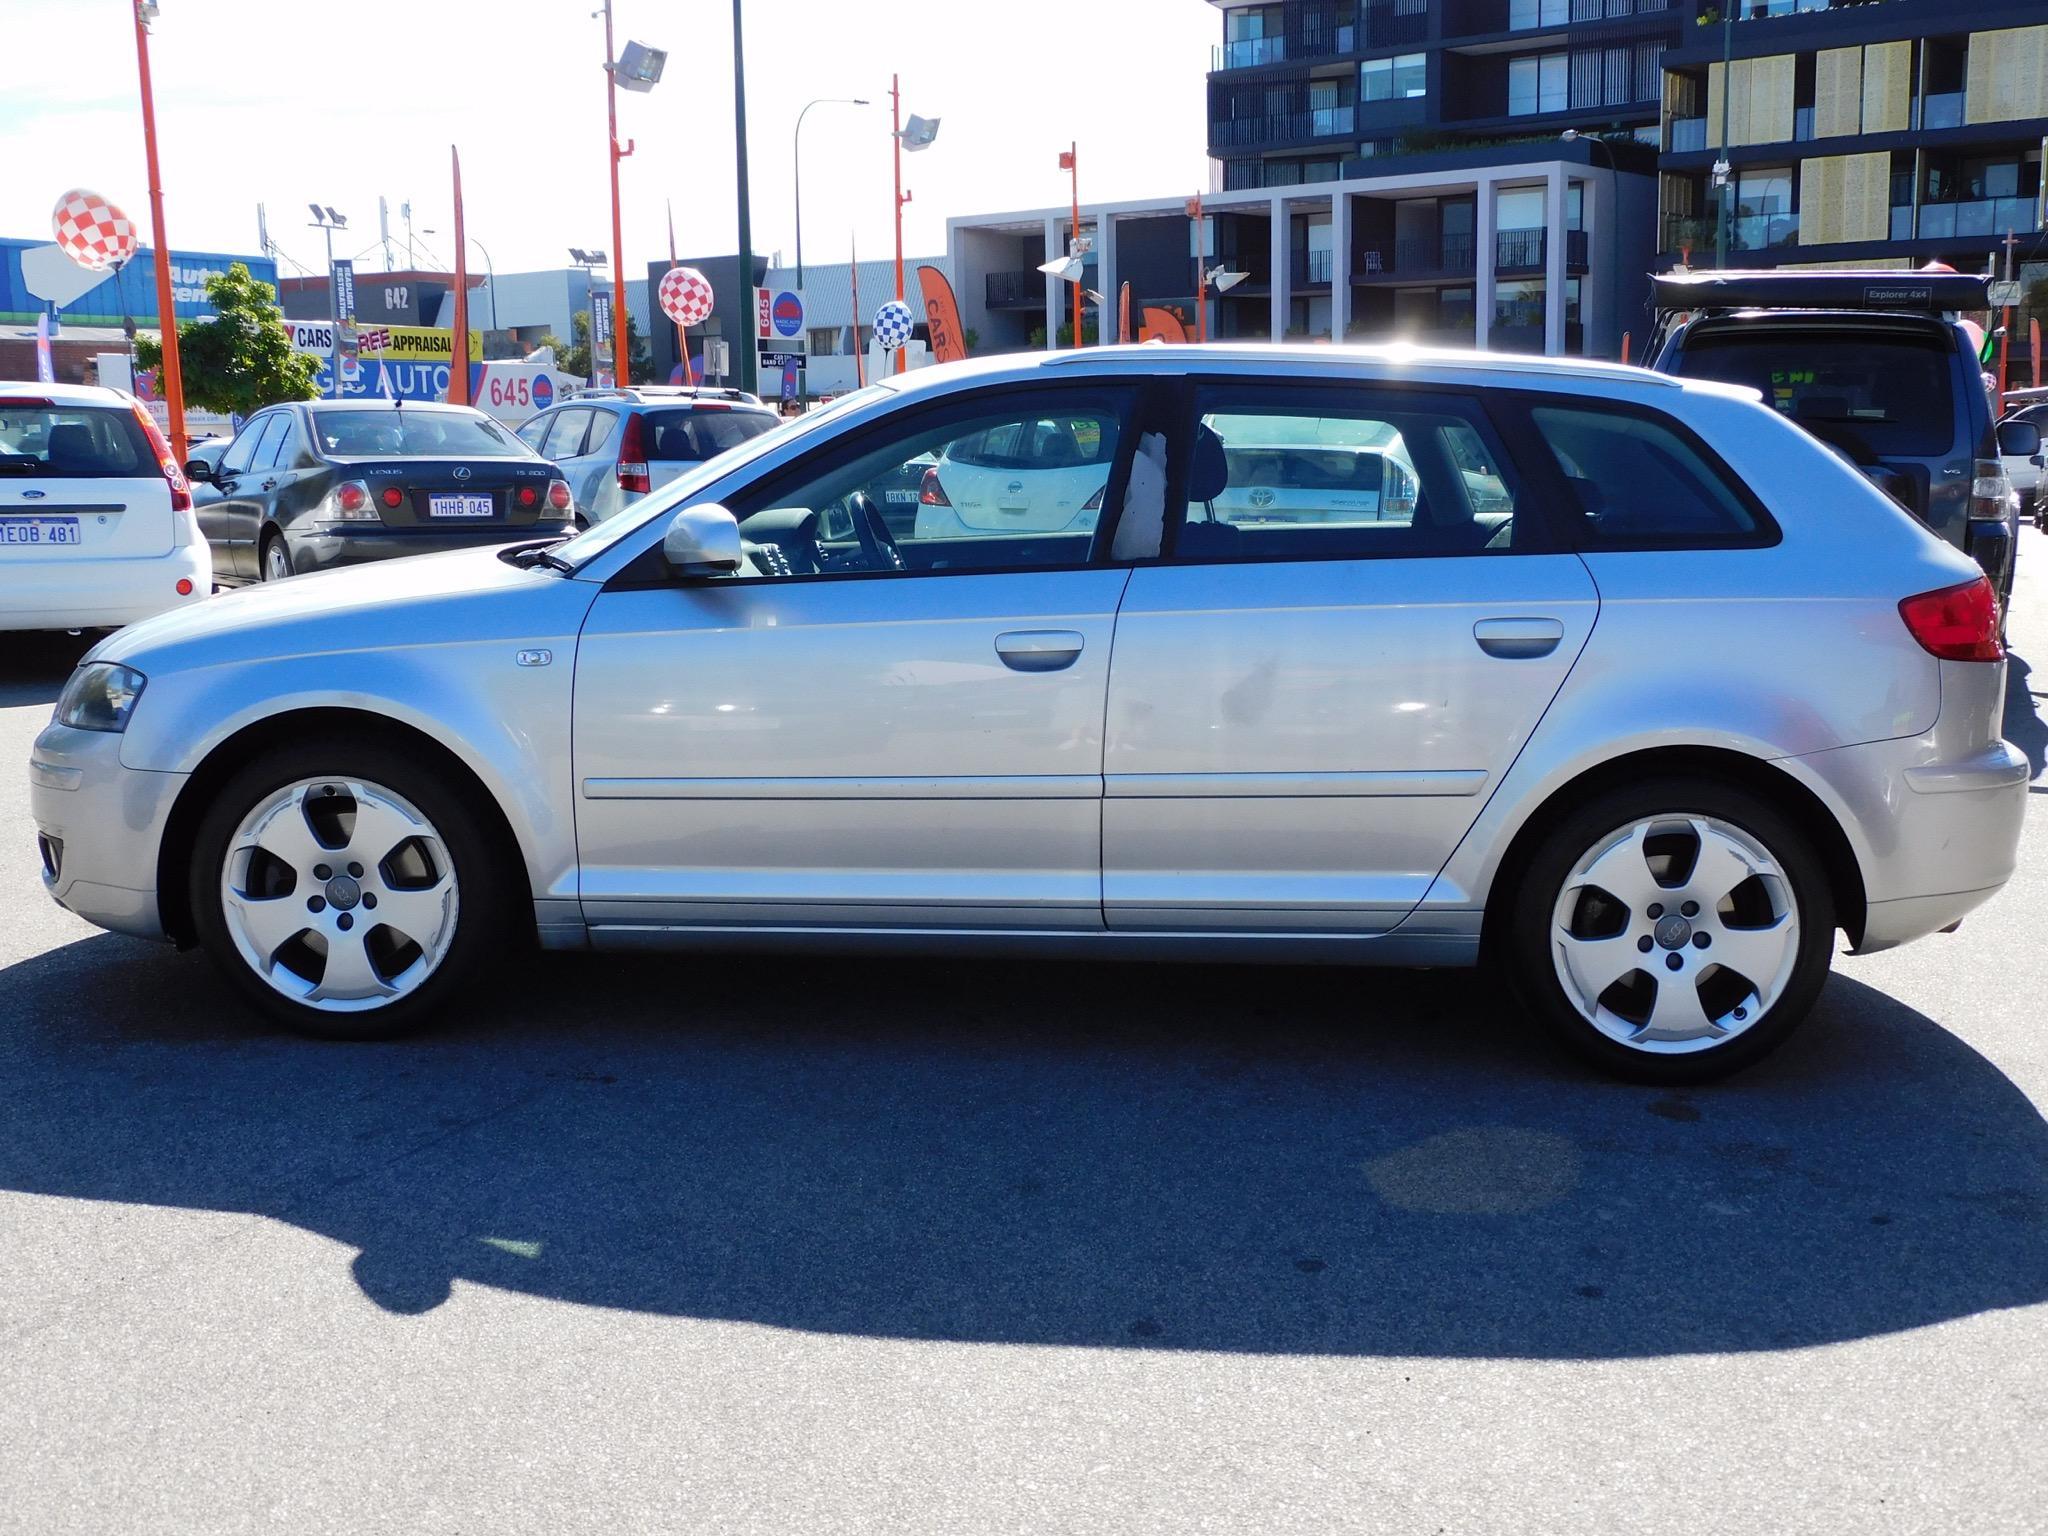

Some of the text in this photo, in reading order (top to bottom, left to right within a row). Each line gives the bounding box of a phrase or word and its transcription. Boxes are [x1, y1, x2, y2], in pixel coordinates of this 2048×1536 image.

[335, 266, 347, 320] RESTORATION
[344, 266, 355, 310] HEADLIGHT
[384, 286, 409, 310] 642
[1868, 290, 1928, 300] Explorer 4x4
[759, 298, 770, 328] 645
[297, 327, 333, 348] CARS
[927, 298, 950, 364] CARS
[490, 377, 529, 407] 645
[434, 500, 490, 515] 1HHB 045
[48, 526, 75, 542] 481
